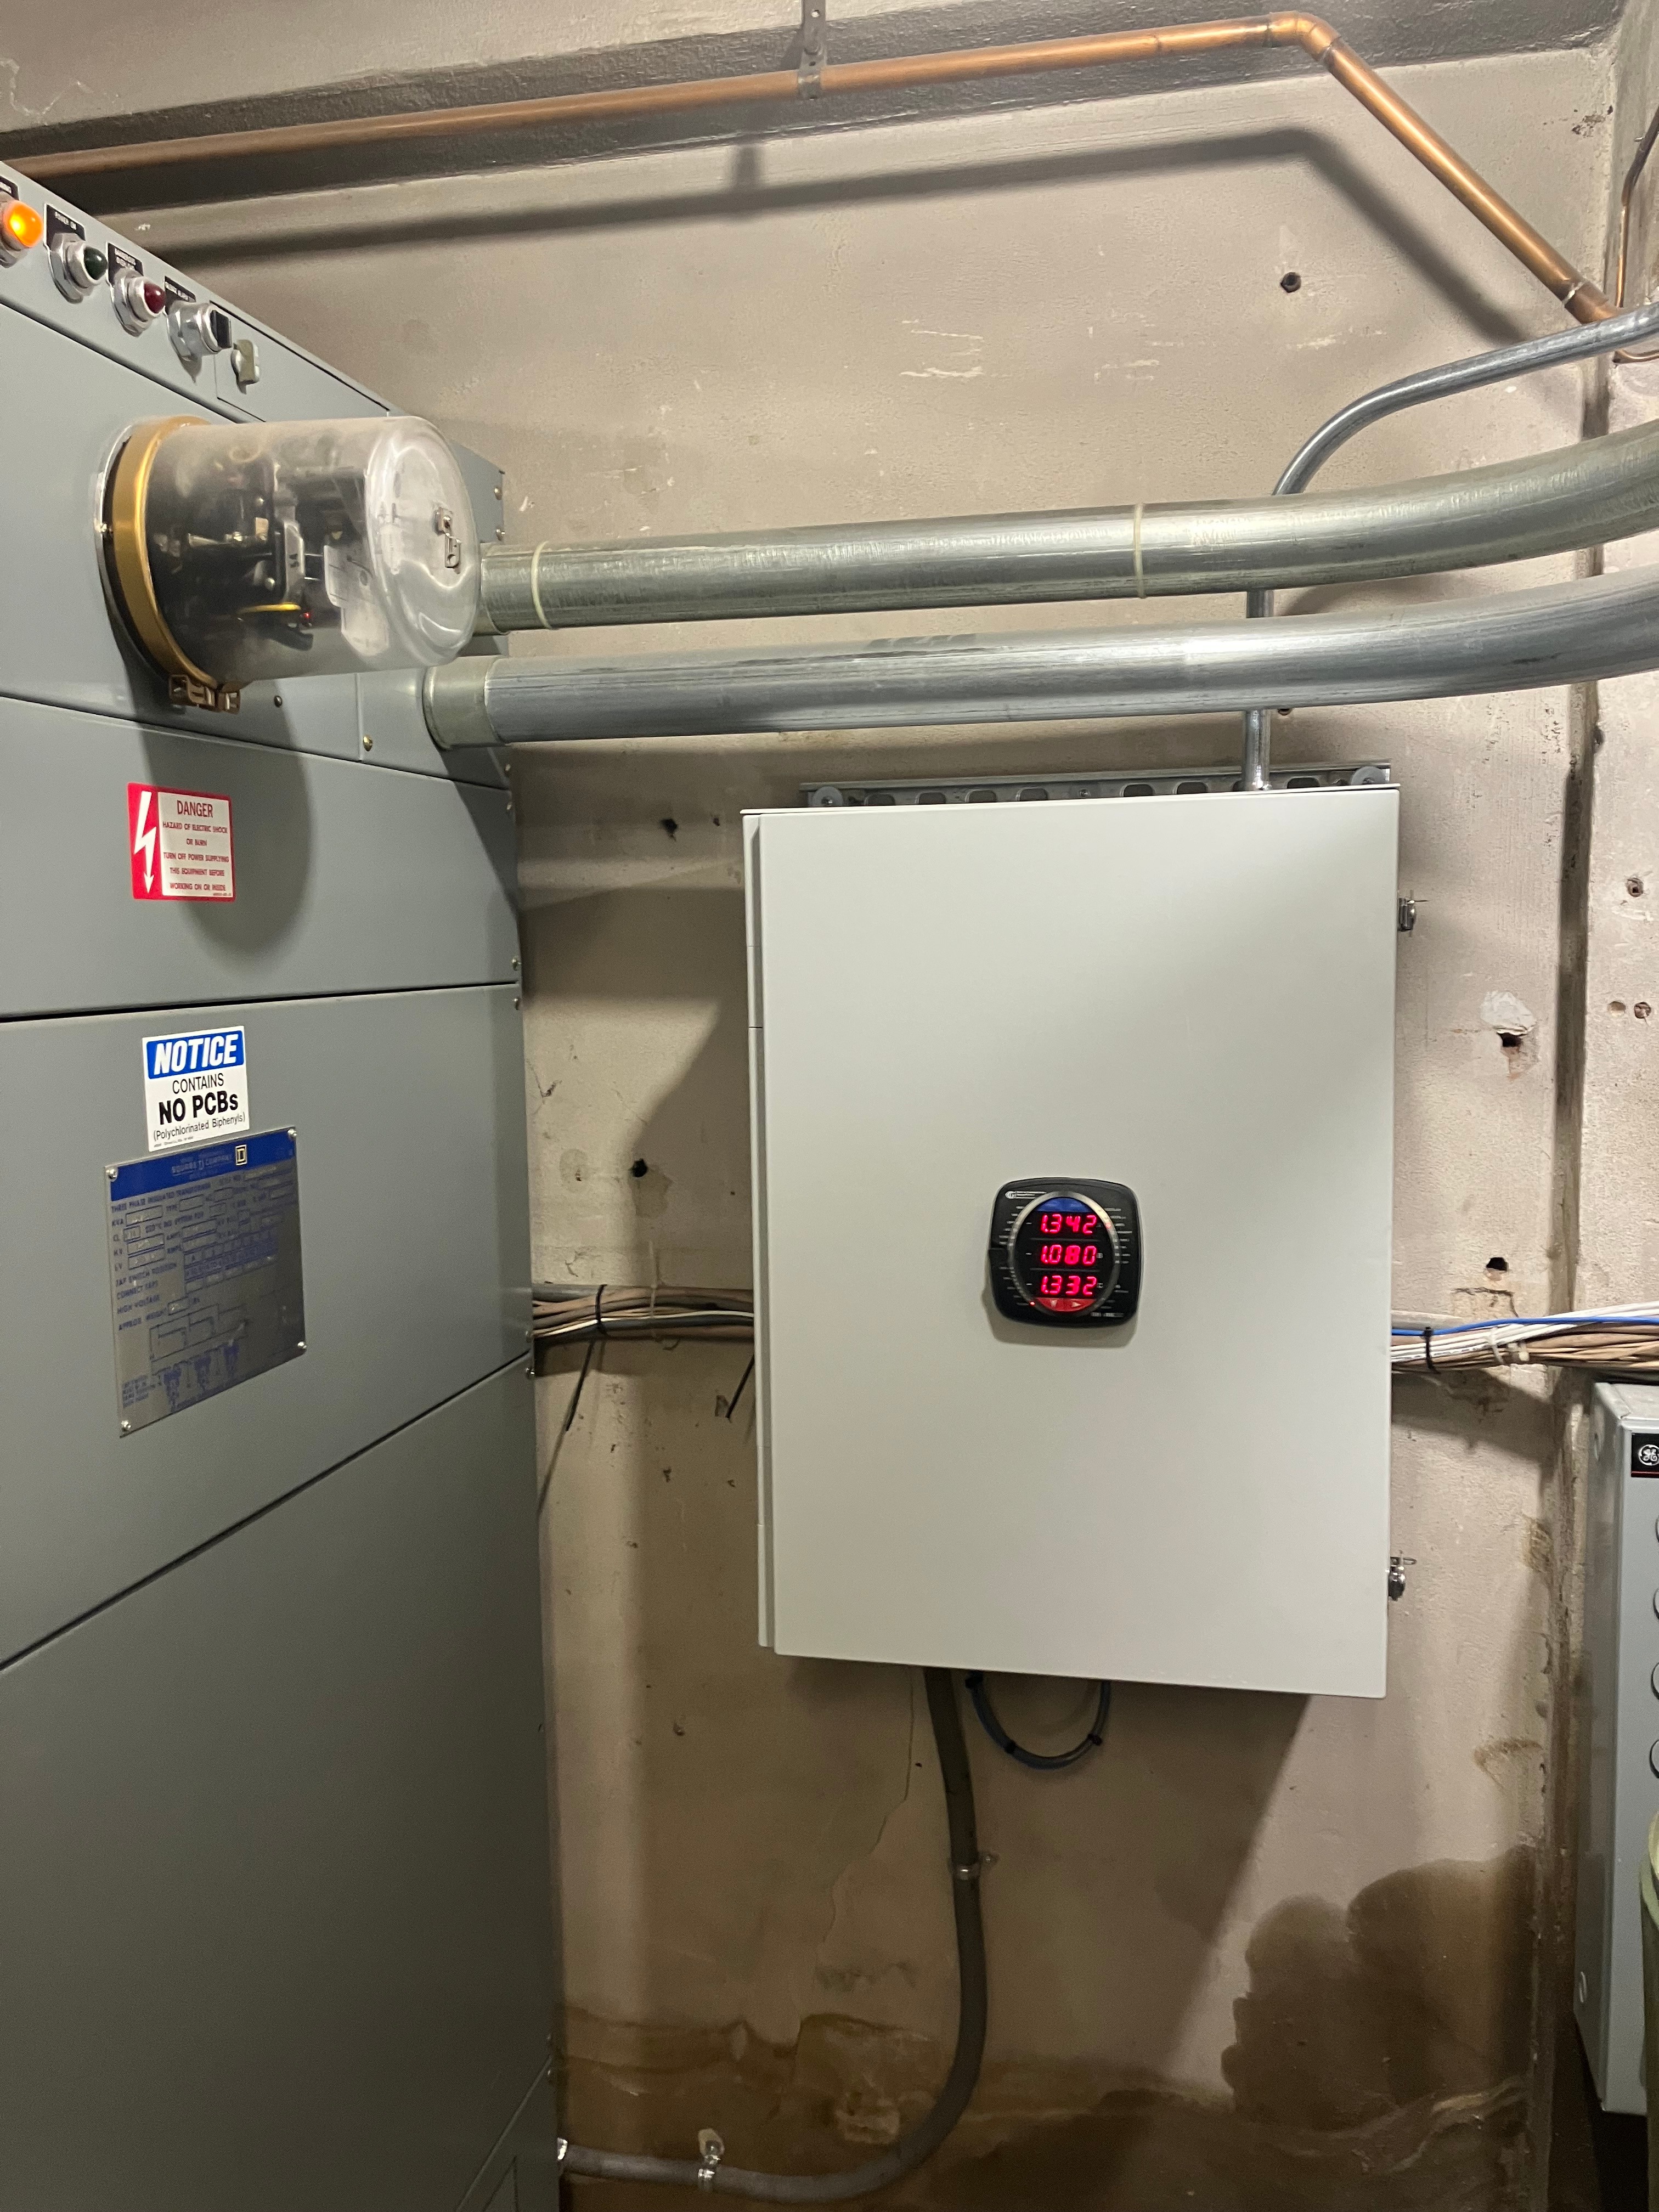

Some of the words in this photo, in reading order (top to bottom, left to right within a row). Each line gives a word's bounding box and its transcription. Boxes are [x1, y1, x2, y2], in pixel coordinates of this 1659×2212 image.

[177, 800, 213, 818] DANGER
[162, 821, 182, 830] HAZARD
[192, 823, 211, 832] ELECTRIC
[205, 855, 229, 863] SUPPLYING
[182, 867, 207, 876] EQUIPMENT
[154, 1034, 239, 1075] NOTICE
[172, 1073, 224, 1094] CONTAINS
[159, 1098, 186, 1125] NO
[192, 1091, 239, 1118] PCBs
[154, 1120, 209, 1142] (Polychlorinated
[212, 1111, 246, 1128] Biphenyls)
[1041, 1214, 1097, 1234] 1.342
[1041, 1244, 1097, 1265] 1.080
[1041, 1275, 1097, 1295] 1.332
